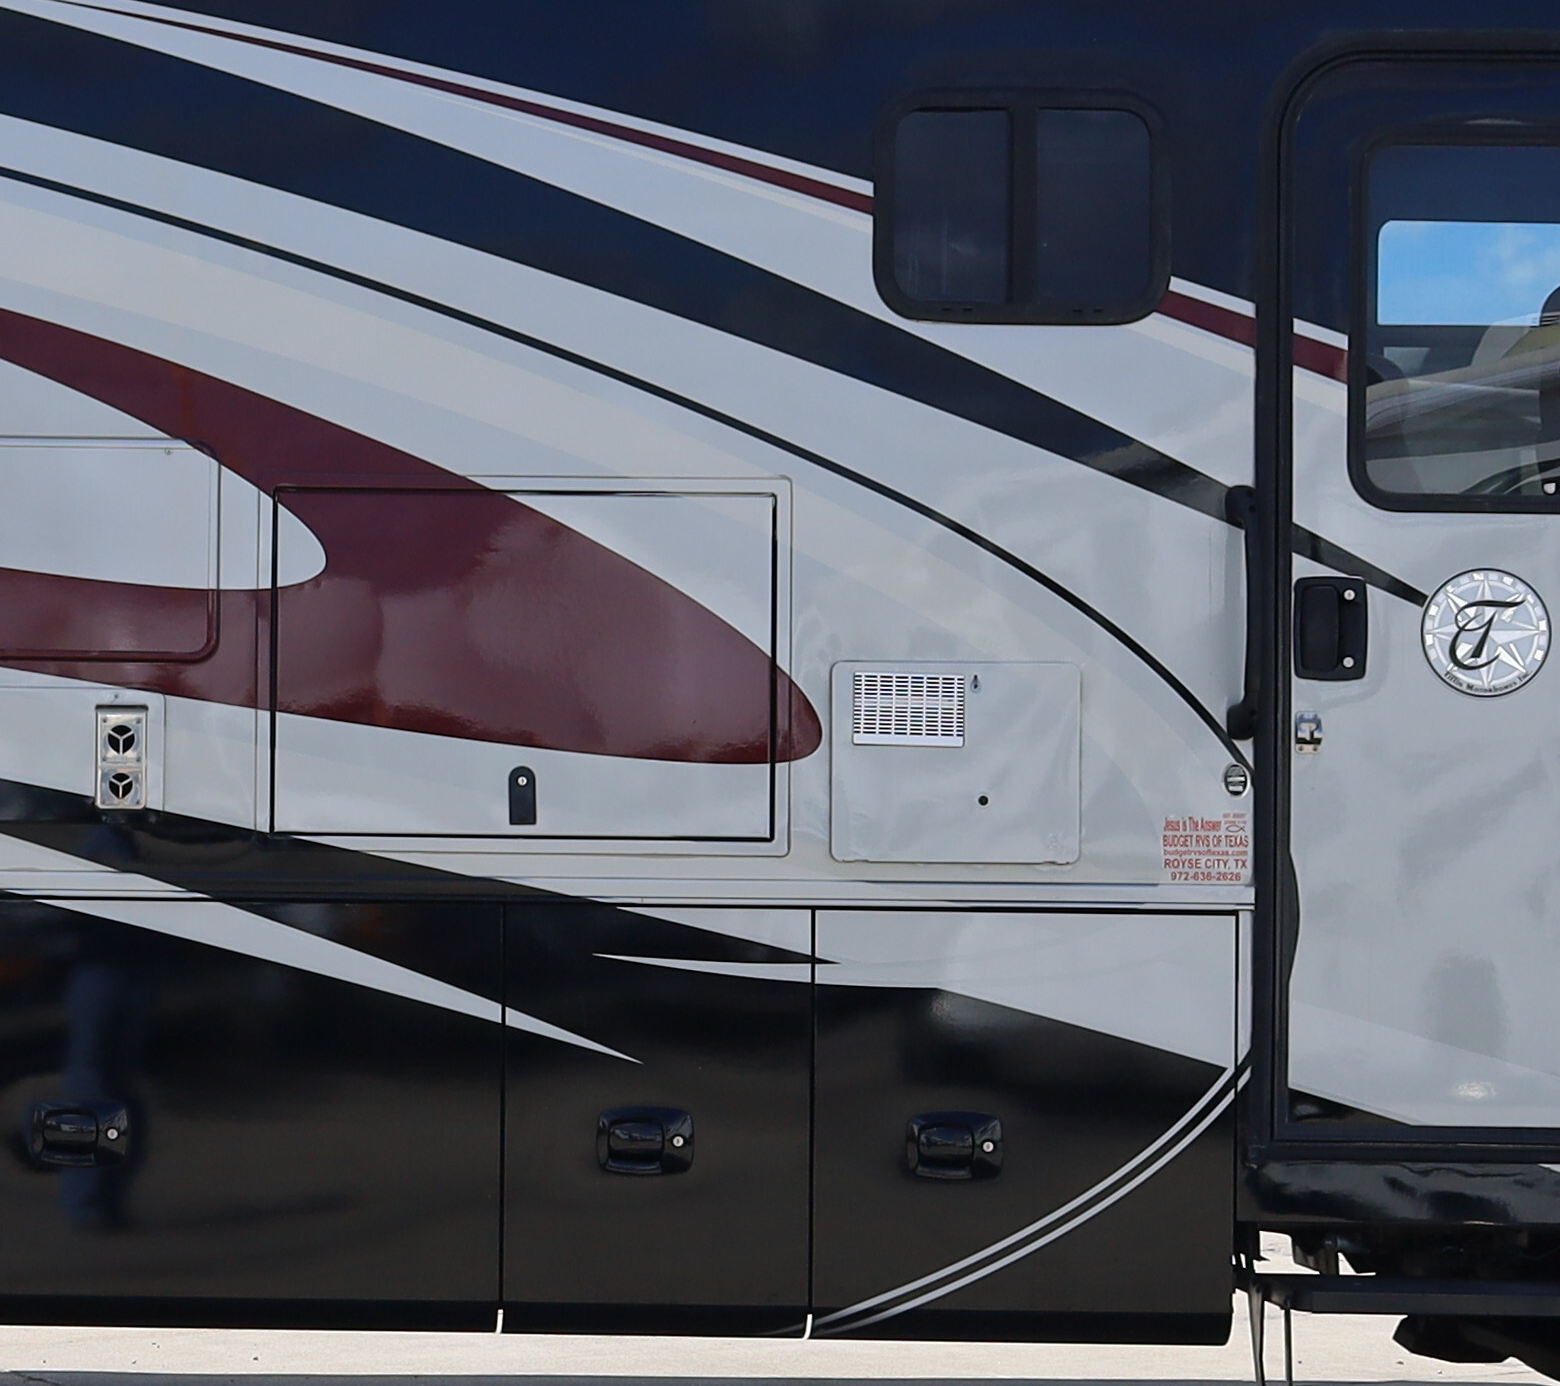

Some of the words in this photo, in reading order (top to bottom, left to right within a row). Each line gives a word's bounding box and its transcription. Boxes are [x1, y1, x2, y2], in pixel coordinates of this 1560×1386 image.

[1163, 834, 1193, 848] BUDGET
[1212, 834, 1222, 848] OF
[1224, 834, 1249, 848] TEXAS
[1164, 858, 1201, 869] ROYSE
[1233, 858, 1248, 869] TX
